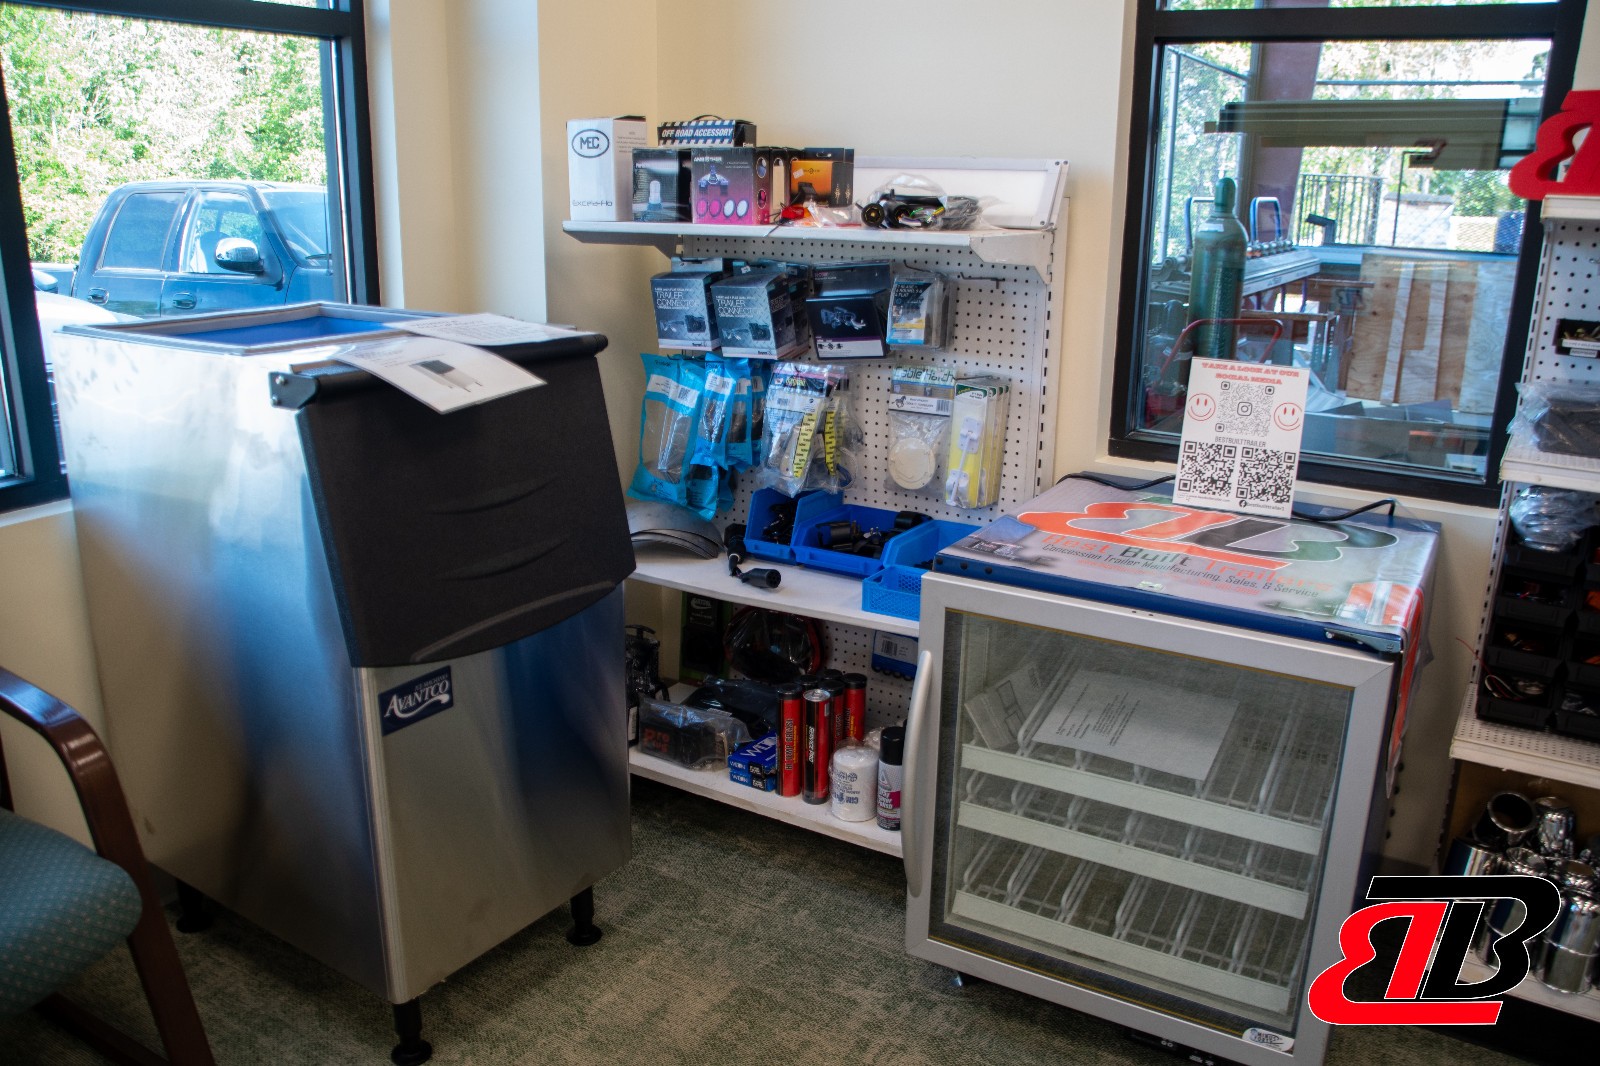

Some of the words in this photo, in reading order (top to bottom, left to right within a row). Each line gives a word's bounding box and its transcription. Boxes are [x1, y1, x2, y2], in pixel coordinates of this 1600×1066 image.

[661, 130, 675, 138] OFF
[675, 129, 693, 138] ROAD
[694, 128, 733, 137] ACCESSORY
[655, 291, 684, 300] TRAILER
[716, 299, 746, 308] TRAILER
[1201, 362, 1229, 371] TAKE
[1238, 365, 1263, 374] LOOK
[1263, 368, 1279, 376] AT
[1278, 369, 1300, 378] OUR
[1215, 372, 1250, 382] SOCIAL
[1250, 376, 1282, 385] MEDIA
[1214, 436, 1267, 448] BESTBUILTTRAILER
[1119, 546, 1192, 567] Built
[1204, 560, 1334, 592] Trailers
[1103, 554, 1141, 567] Trailer
[1224, 575, 1259, 590] Sales,
[1262, 582, 1273, 590] &
[1273, 584, 1320, 598] Service
[384, 680, 449, 718] AVANTCO
[784, 744, 793, 762] TEMP
[784, 763, 793, 771] HI
